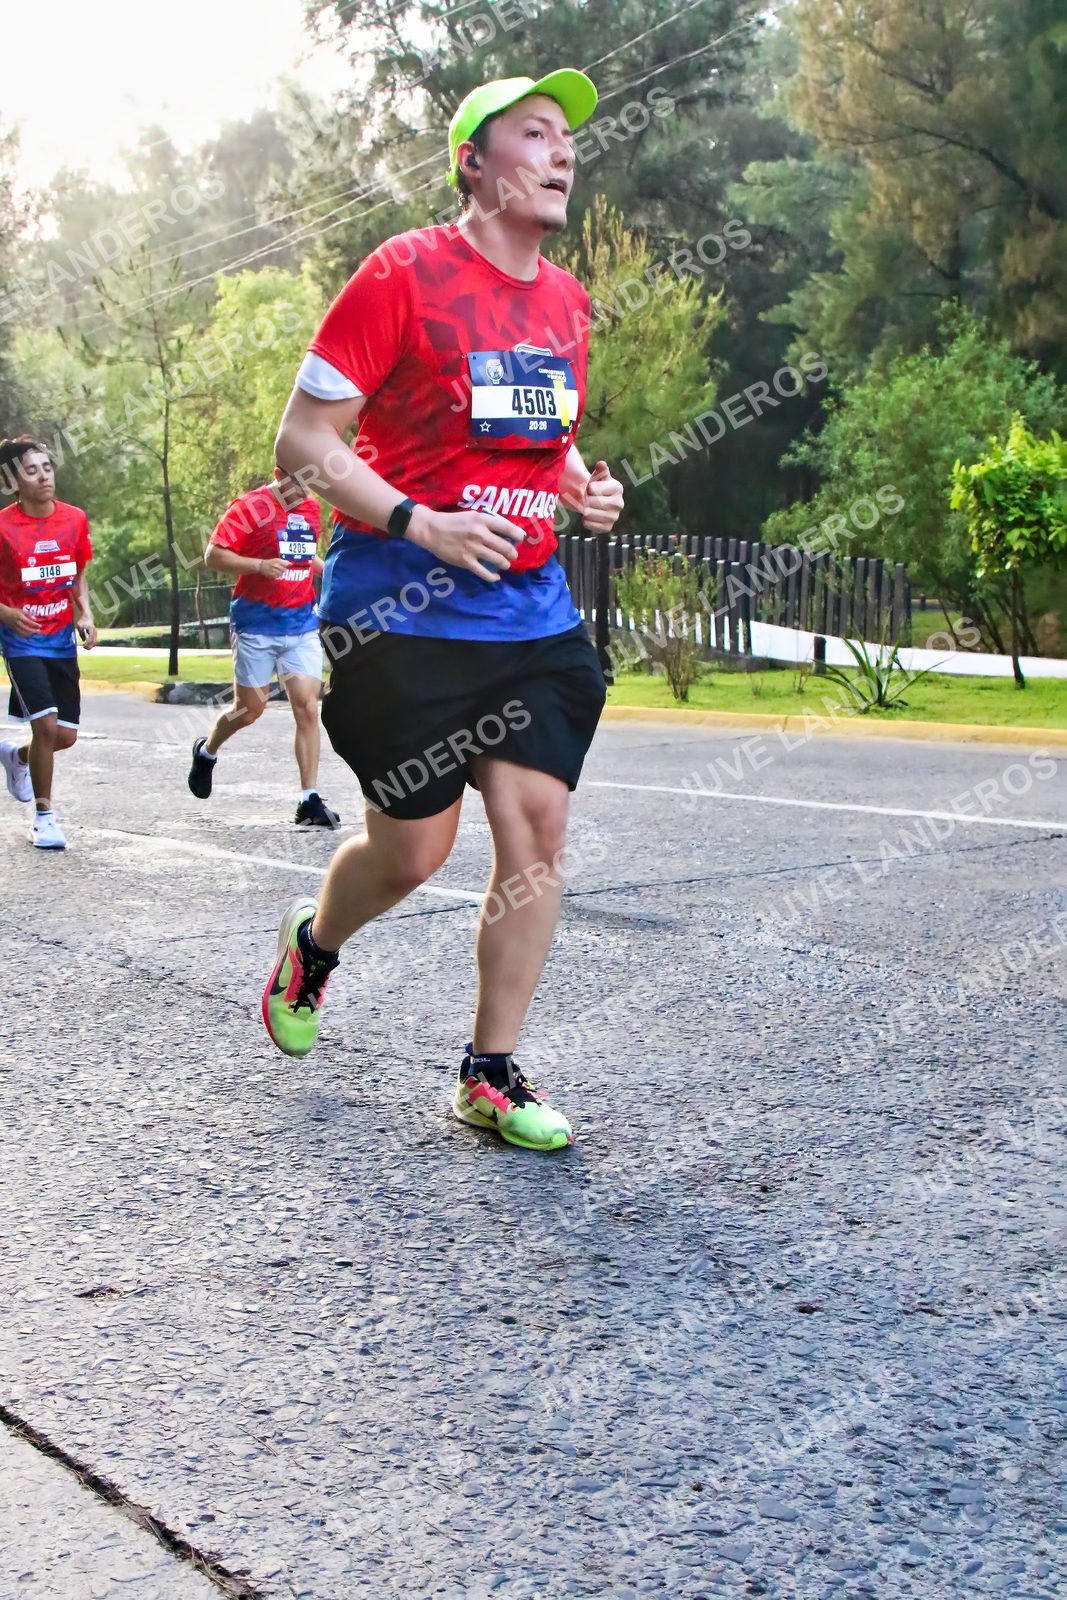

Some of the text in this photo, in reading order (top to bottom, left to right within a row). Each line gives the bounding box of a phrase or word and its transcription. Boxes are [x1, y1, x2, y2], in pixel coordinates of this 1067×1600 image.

[512, 388, 557, 416] 4503
[457, 484, 559, 519] SANTIAG
[288, 543, 307, 554] 4205
[39, 565, 61, 578] 3148
